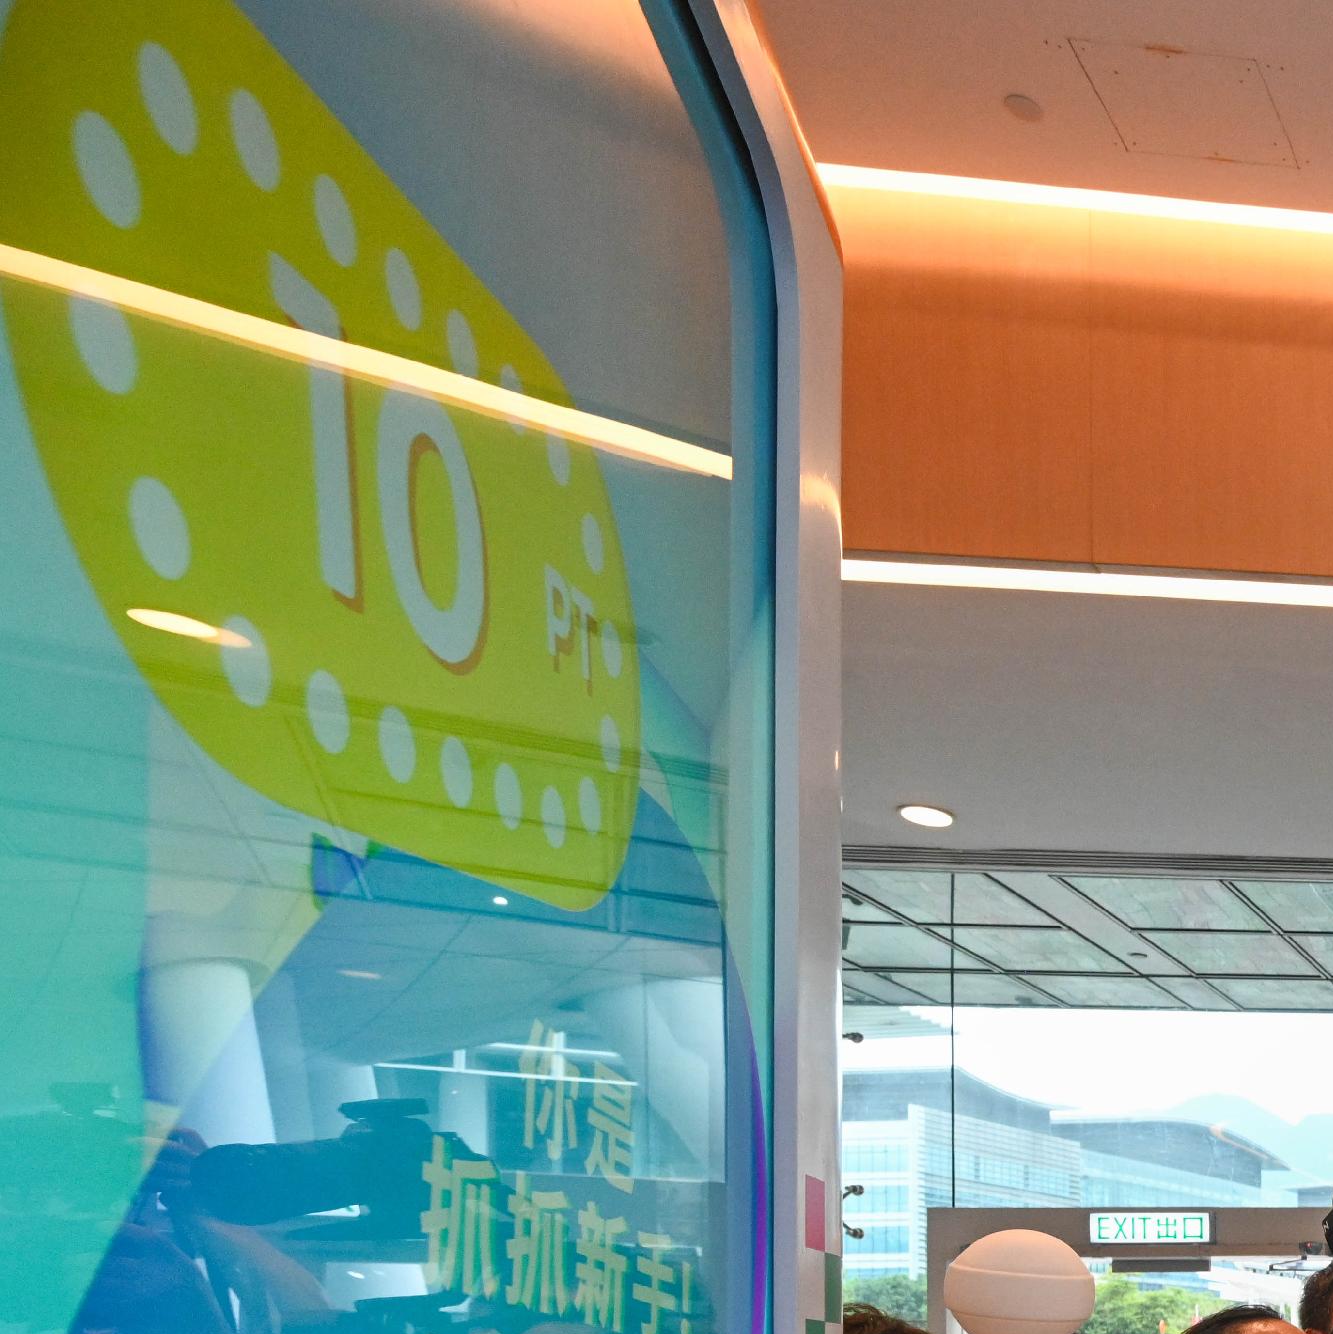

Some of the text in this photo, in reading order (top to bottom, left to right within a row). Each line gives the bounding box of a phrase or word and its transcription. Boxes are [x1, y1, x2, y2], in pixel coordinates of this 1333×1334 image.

[267, 250, 596, 688] 10 PT
[519, 1017, 636, 1195] 你是
[1098, 1217, 1204, 1240] EXIT 出口
